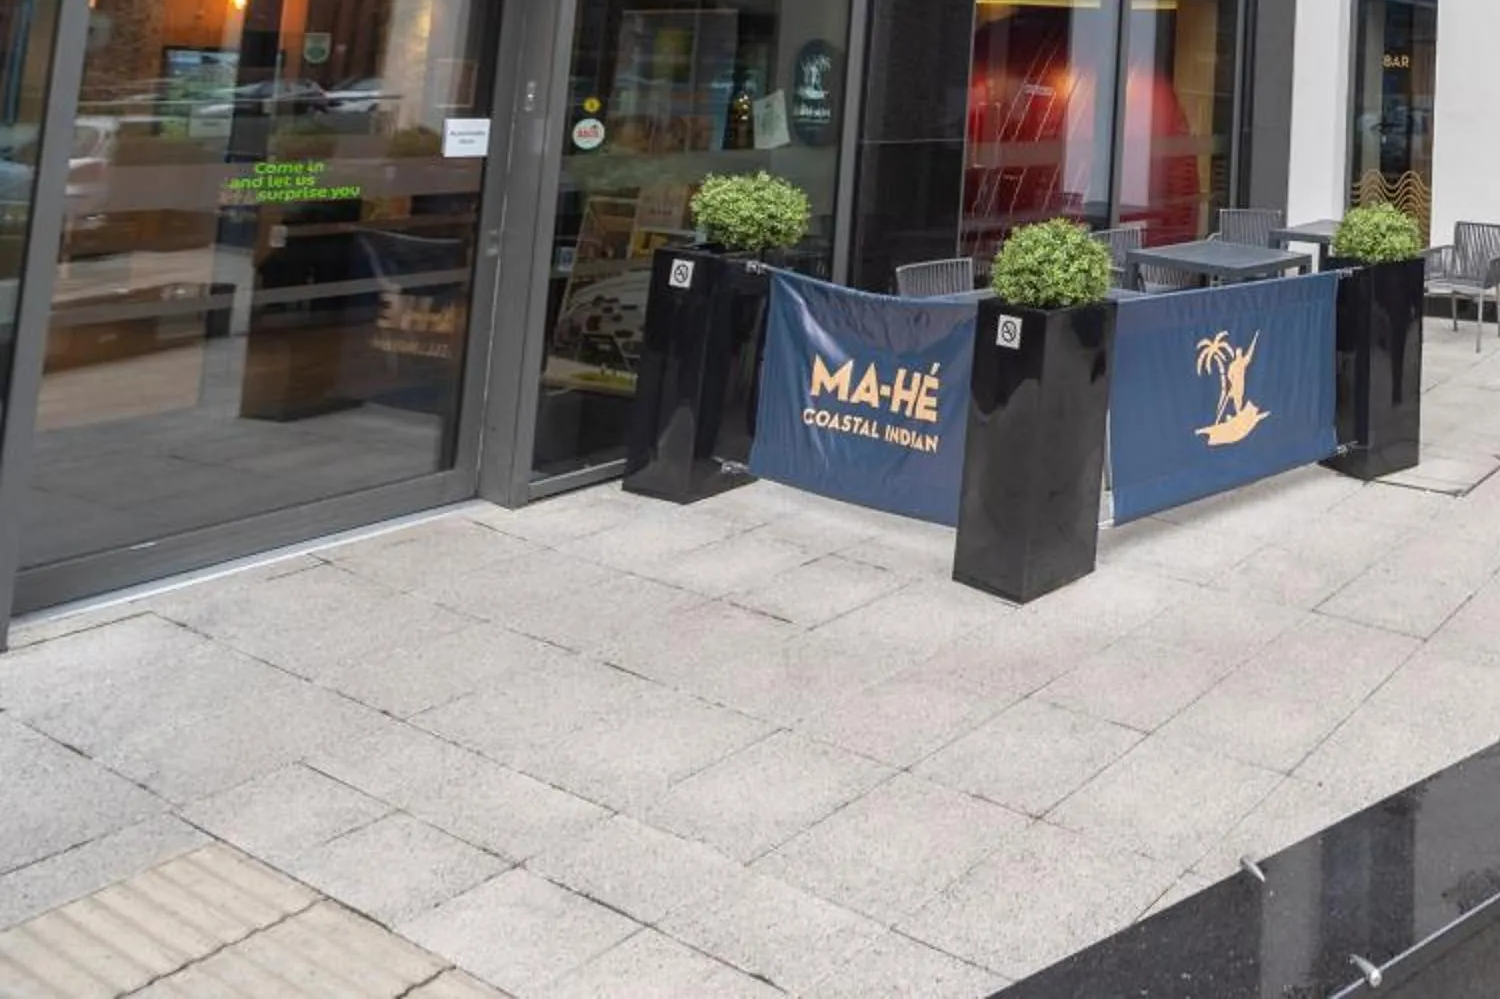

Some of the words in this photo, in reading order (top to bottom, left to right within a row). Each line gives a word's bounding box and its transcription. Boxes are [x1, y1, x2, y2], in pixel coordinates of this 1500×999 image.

[255, 162, 304, 174] Come
[295, 175, 315, 186] us
[810, 353, 940, 422] MA-HÉ
[803, 408, 880, 438] COASTAL
[885, 424, 939, 453] INDIAN
